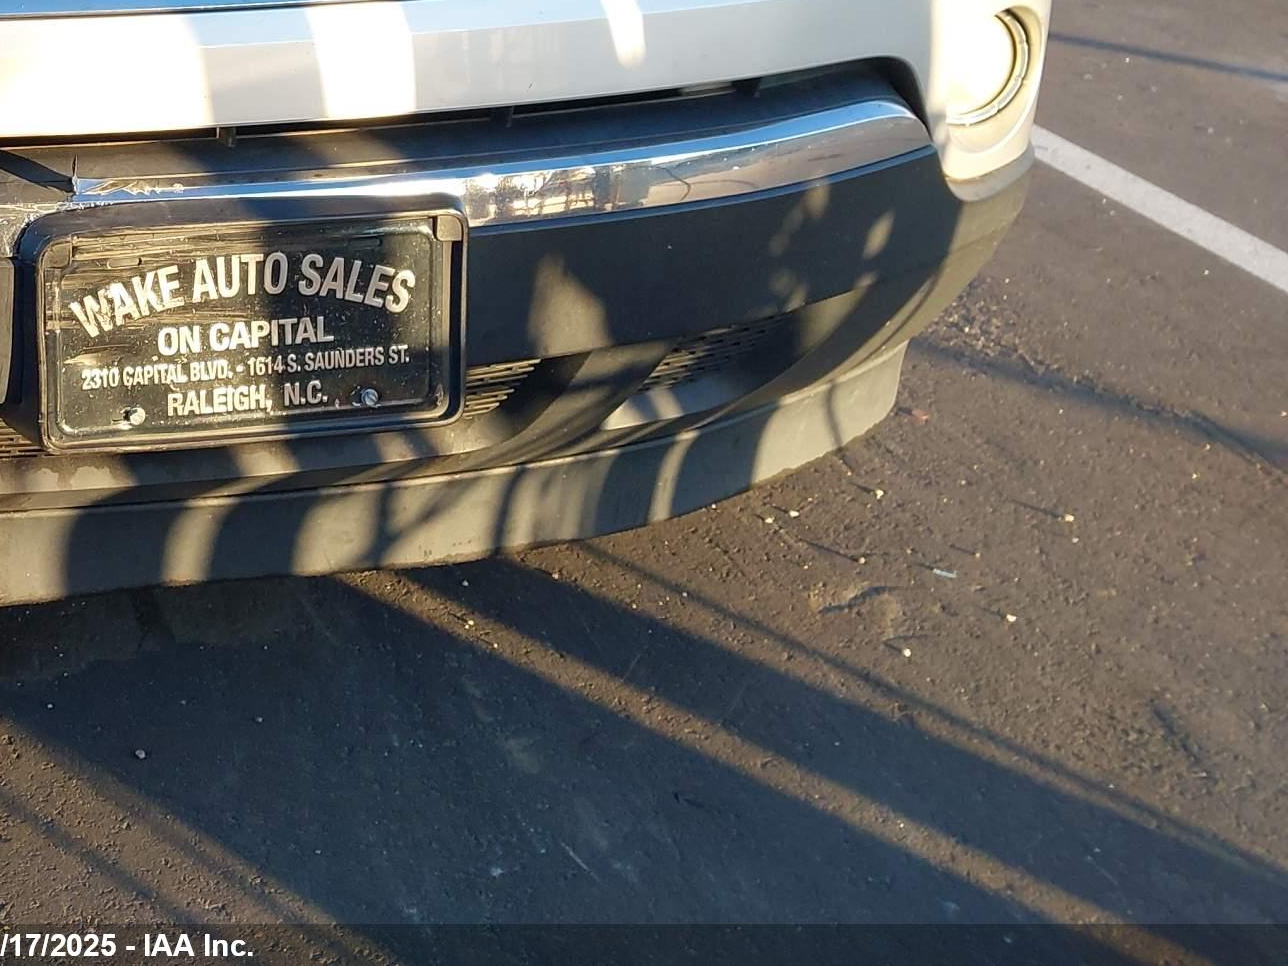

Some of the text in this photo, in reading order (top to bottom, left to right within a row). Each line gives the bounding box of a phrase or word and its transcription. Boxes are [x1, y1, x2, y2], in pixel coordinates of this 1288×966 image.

[68, 251, 416, 338] WAKE AUTO SALES
[157, 316, 334, 357] ON CAPITAL
[81, 366, 120, 391] 2310
[122, 361, 188, 388] CAPITAL
[189, 359, 233, 383] BLVD.
[304, 346, 384, 372] SAUNDERS
[388, 344, 409, 365] ST.
[166, 380, 328, 417] RALEIGH, N.C.
